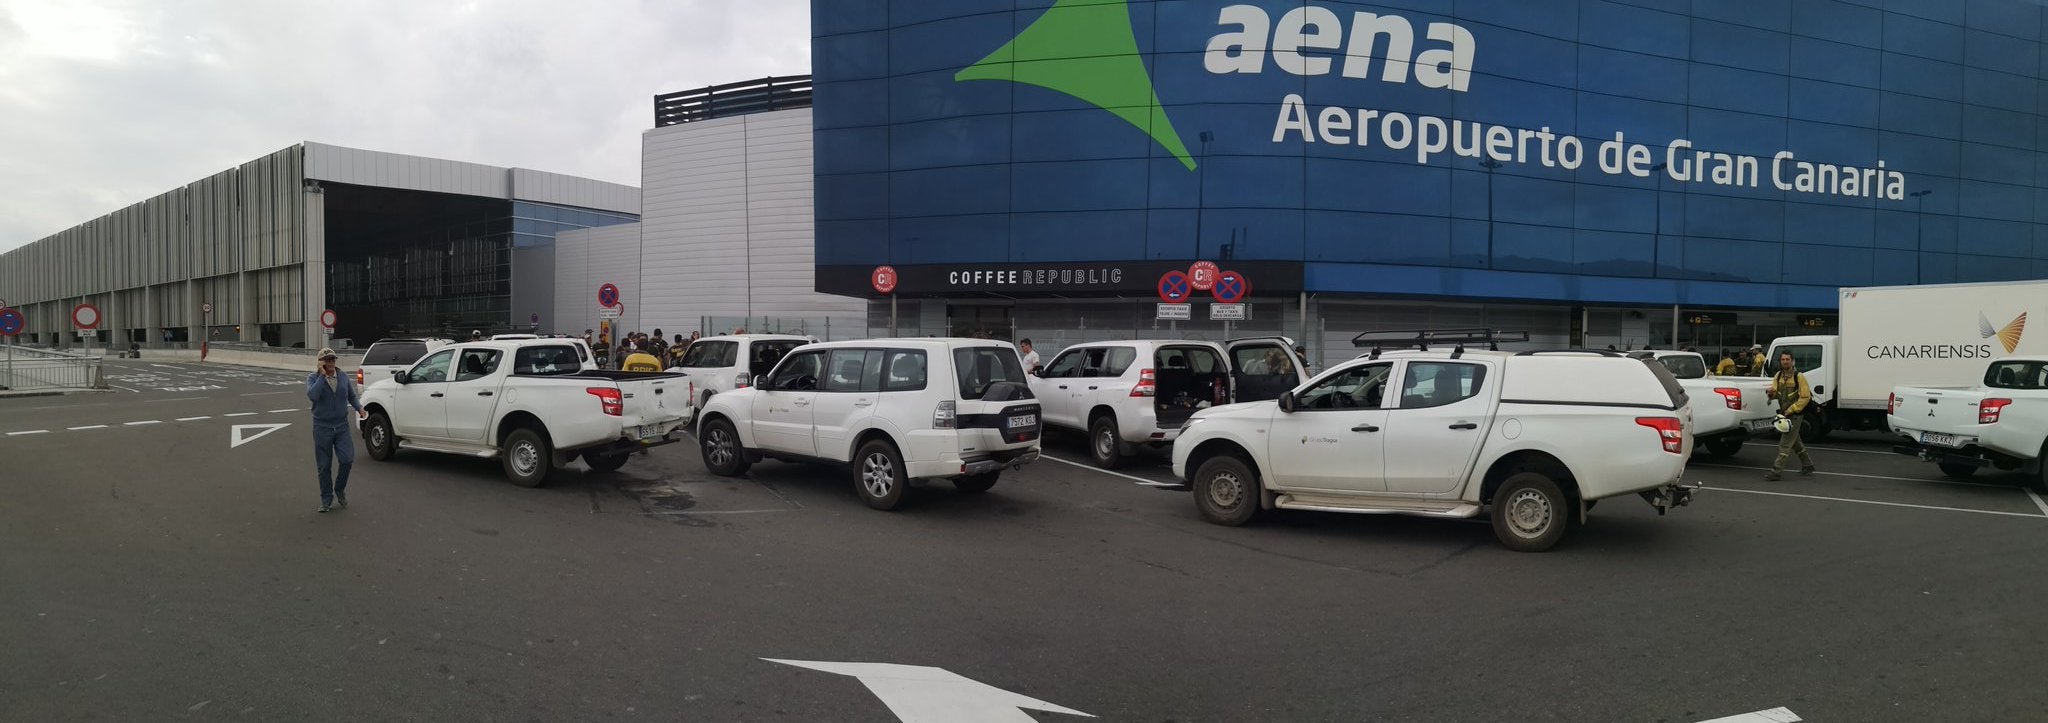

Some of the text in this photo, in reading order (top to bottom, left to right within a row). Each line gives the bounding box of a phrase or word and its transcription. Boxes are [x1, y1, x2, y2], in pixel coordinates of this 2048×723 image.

[1204, 5, 1475, 92] aena
[1273, 94, 1904, 200] Aeropuerto de Gran Canaria
[950, 268, 1121, 285] COFFEE REPUBLIC
[1867, 344, 1991, 359] CANARIENSIS
